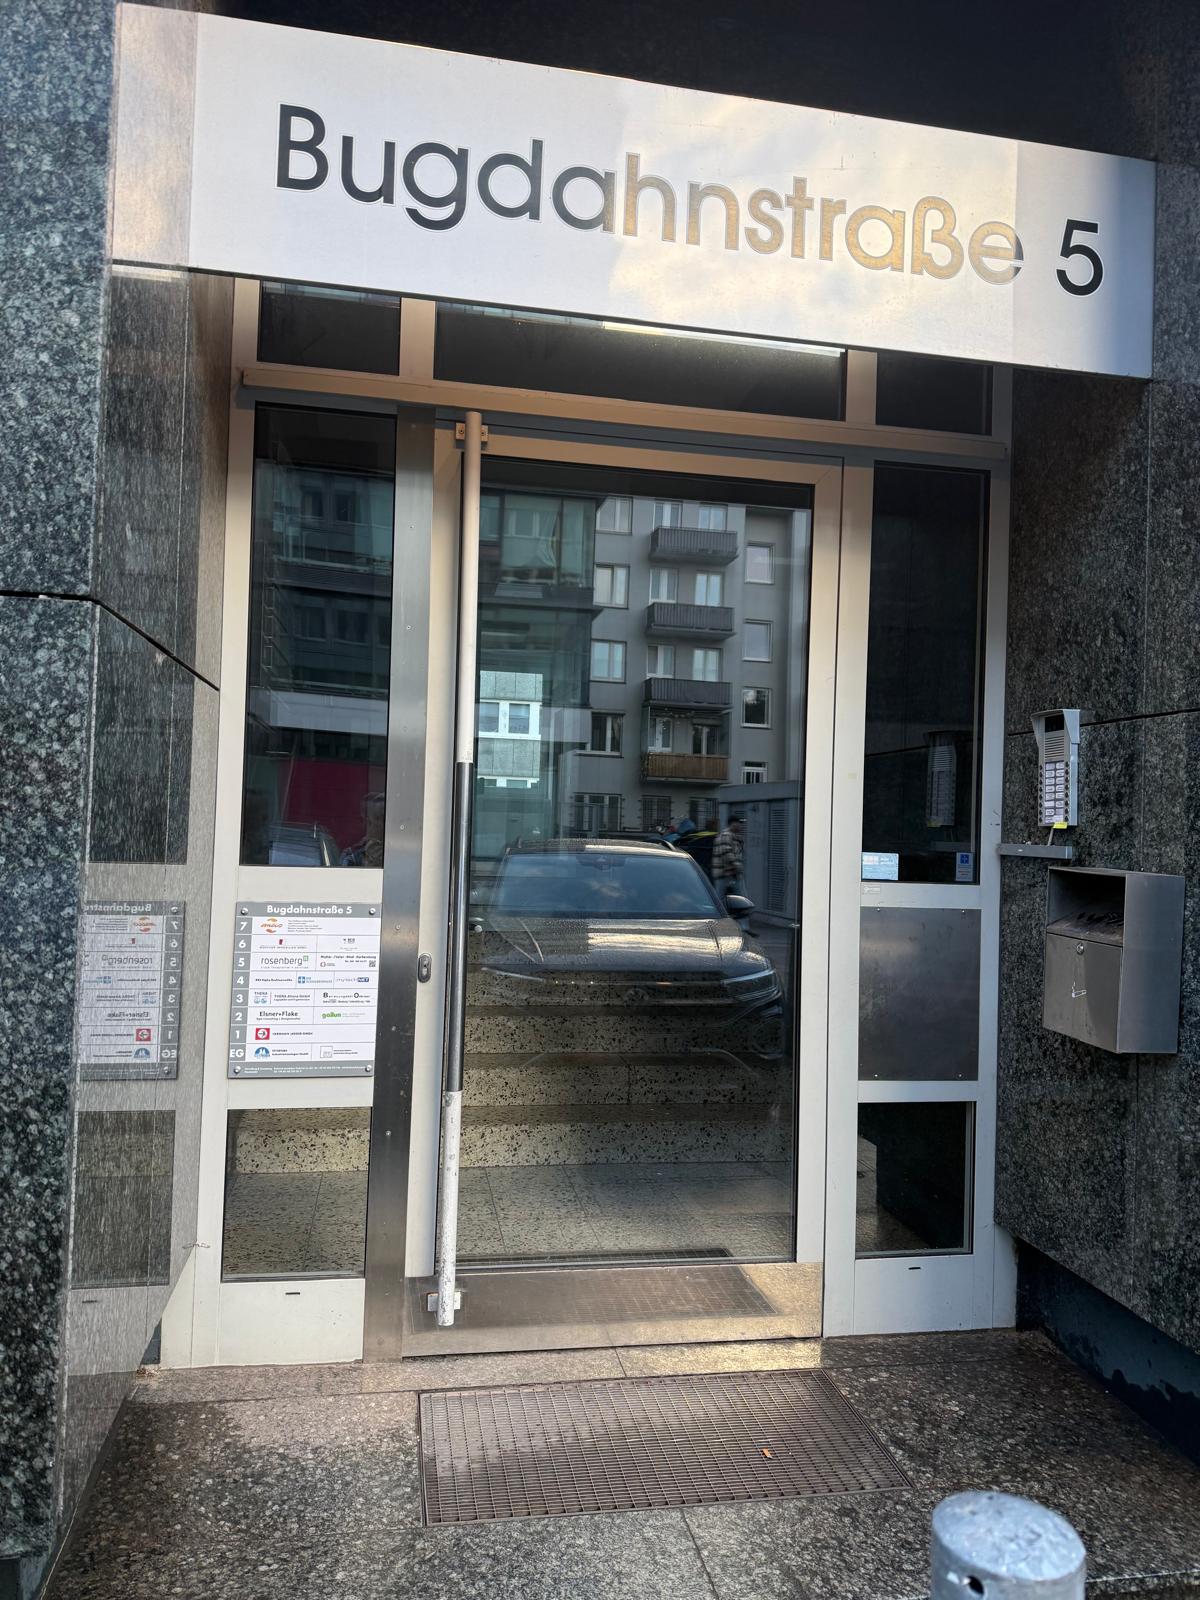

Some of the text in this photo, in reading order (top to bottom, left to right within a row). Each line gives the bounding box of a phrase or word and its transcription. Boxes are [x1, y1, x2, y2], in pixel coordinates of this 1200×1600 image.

[275, 103, 1104, 296] Bugdahnstraße 5
[267, 905, 353, 915] Bugdahnstraße 5
[240, 922, 248, 931] 7
[238, 939, 246, 949] 6
[238, 957, 245, 967] 5
[260, 956, 303, 967] rosenberg
[236, 976, 245, 985] 4
[236, 994, 243, 1003] 3
[235, 1012, 243, 1021] 2
[235, 1030, 240, 1039] 1
[229, 1049, 245, 1058] EG
